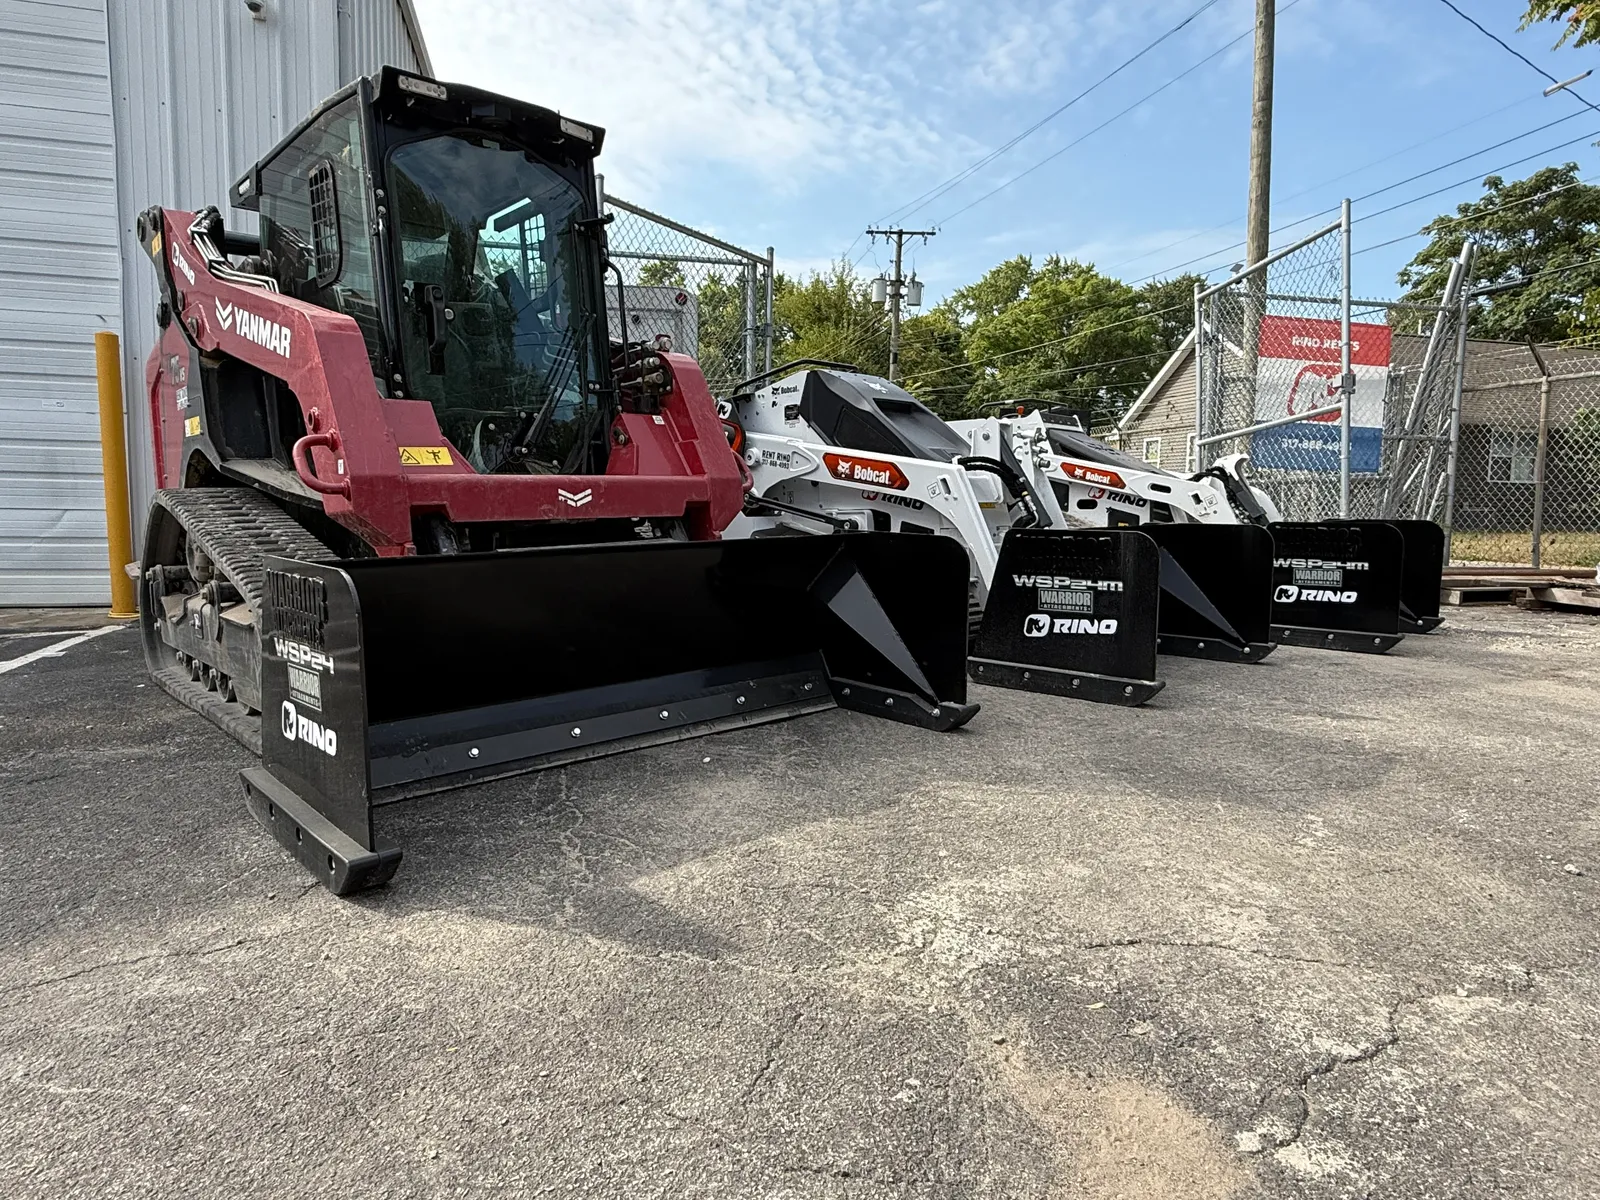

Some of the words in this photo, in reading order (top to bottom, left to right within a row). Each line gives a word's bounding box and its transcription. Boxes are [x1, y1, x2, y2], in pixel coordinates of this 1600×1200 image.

[234, 306, 291, 359] YANMAR
[781, 385, 798, 394] Bobcat
[762, 450, 775, 459] RENT
[854, 465, 890, 485] Bobcat
[1085, 472, 1111, 484] Bobcat
[1107, 490, 1148, 507] RINO
[1295, 570, 1340, 581] WARRIOR
[1041, 590, 1091, 606] WARRIOR
[1300, 589, 1358, 603] RINO
[1053, 618, 1118, 634] RINO
[274, 636, 335, 675] WSP24
[297, 714, 338, 756] RINO
